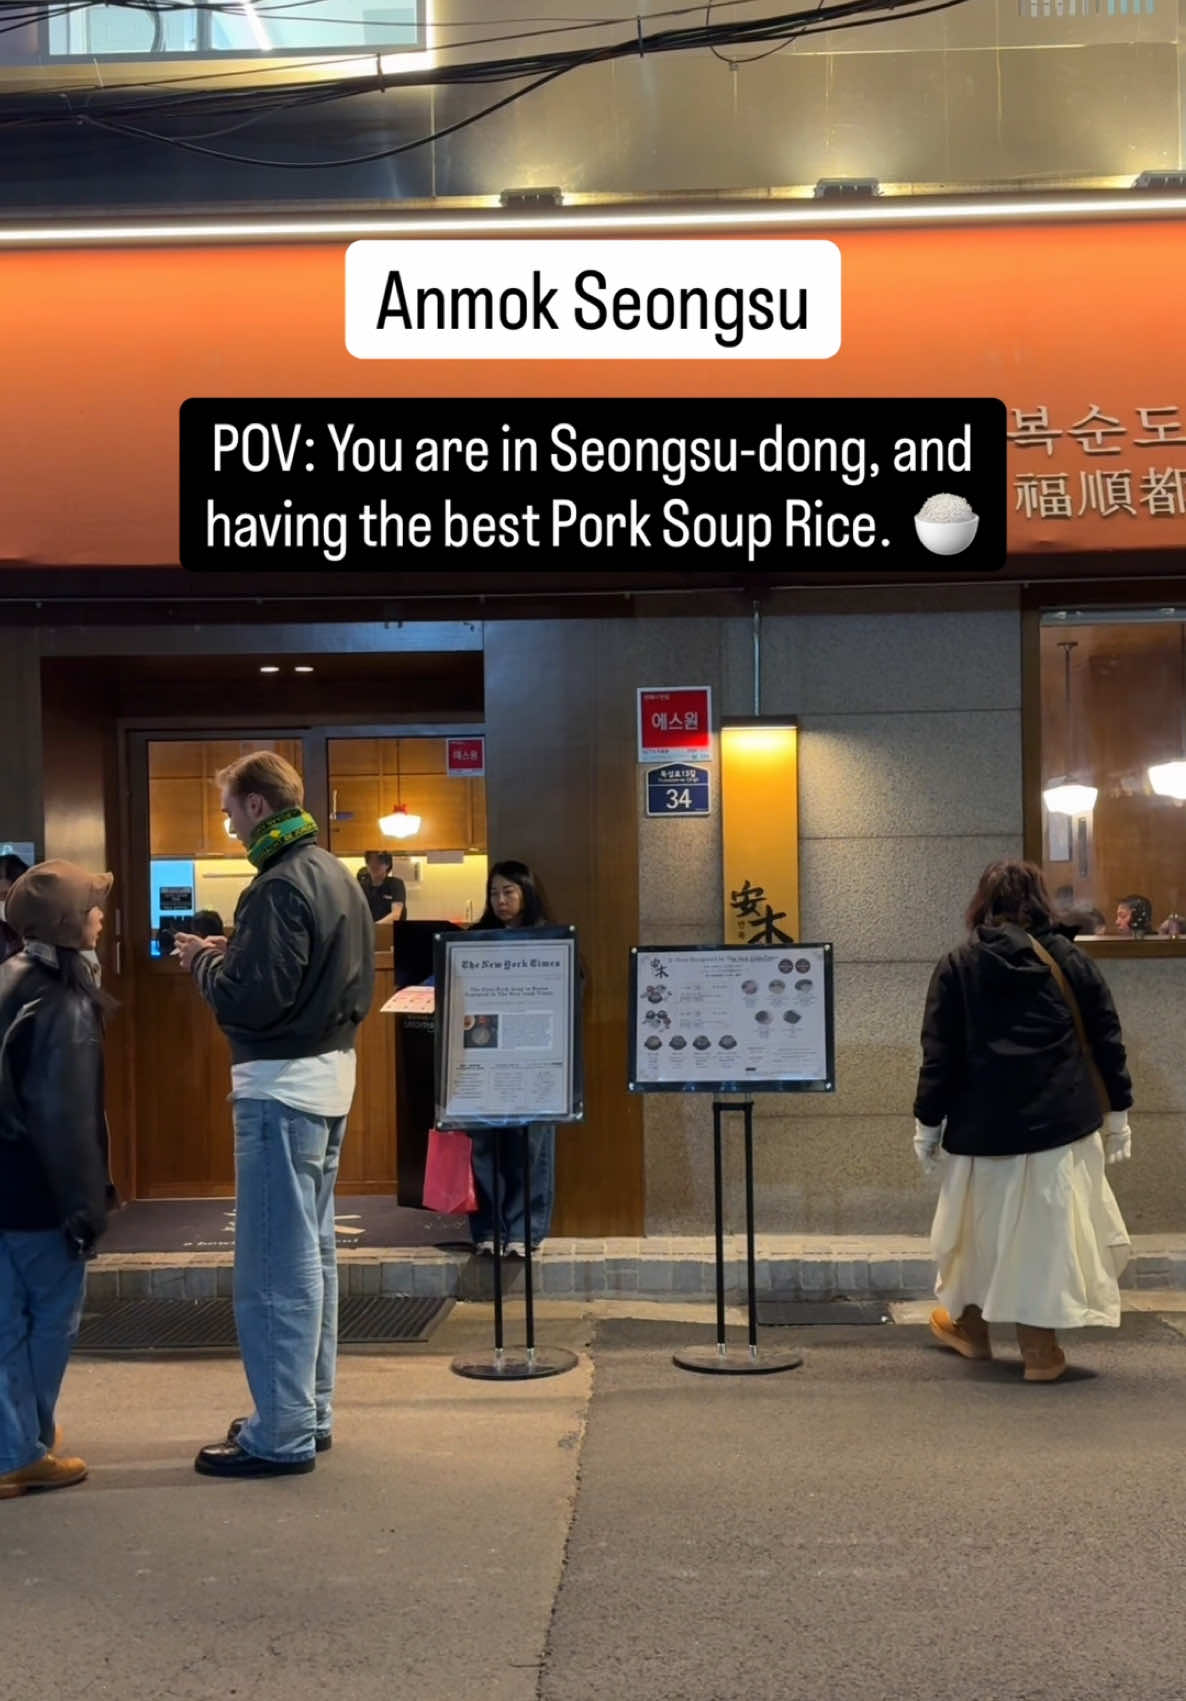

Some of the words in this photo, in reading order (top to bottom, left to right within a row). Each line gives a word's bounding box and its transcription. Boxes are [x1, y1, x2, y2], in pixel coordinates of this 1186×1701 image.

[1007, 404, 1186, 456] 복순도
[651, 711, 699, 731] 에스원
[665, 788, 692, 809] 34
[730, 880, 794, 944] 安木
[461, 959, 480, 969] The
[481, 959, 502, 969] New
[503, 959, 528, 970] York
[530, 958, 560, 968] Times
